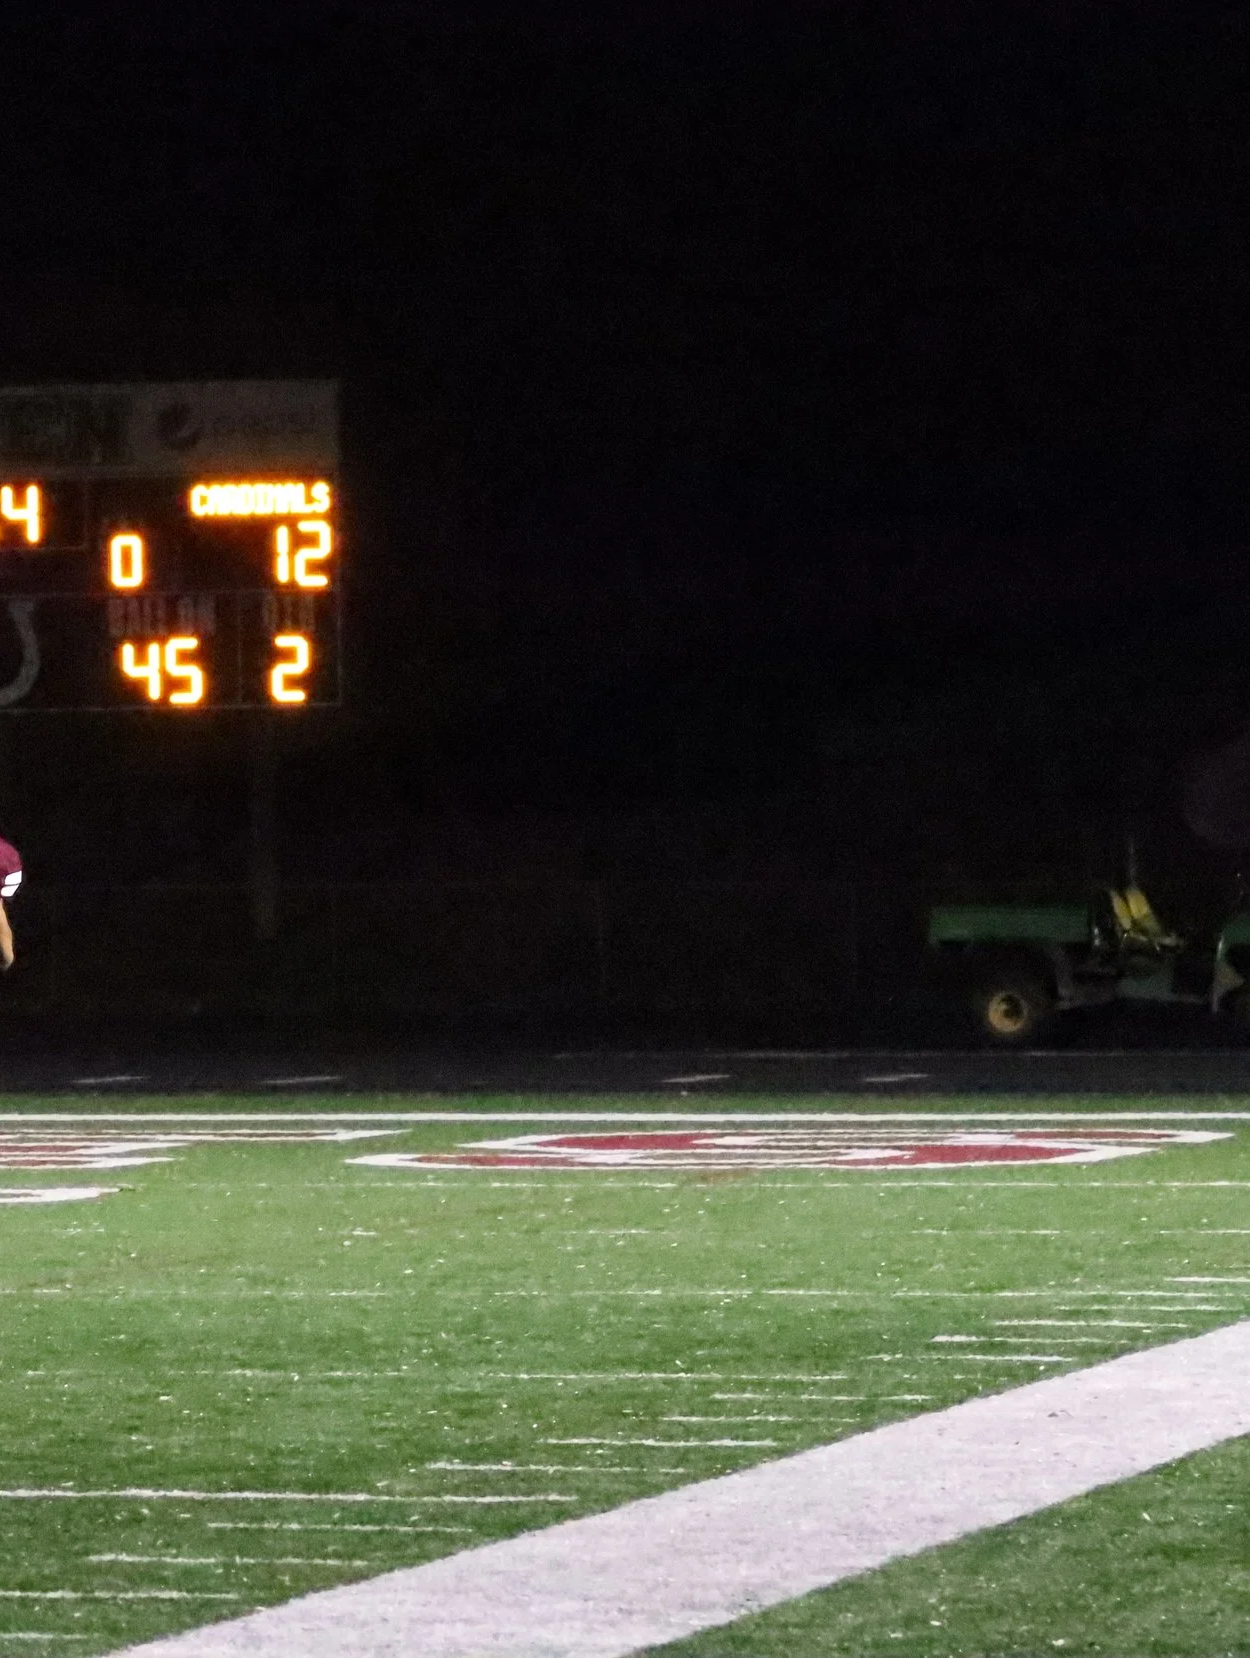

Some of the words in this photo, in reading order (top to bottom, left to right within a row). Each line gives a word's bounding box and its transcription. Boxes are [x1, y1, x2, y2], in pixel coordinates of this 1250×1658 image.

[189, 481, 332, 515] CARDINALS
[110, 533, 144, 589] 0
[274, 519, 332, 588] 12
[121, 636, 205, 706] 45
[270, 633, 310, 703] 2
